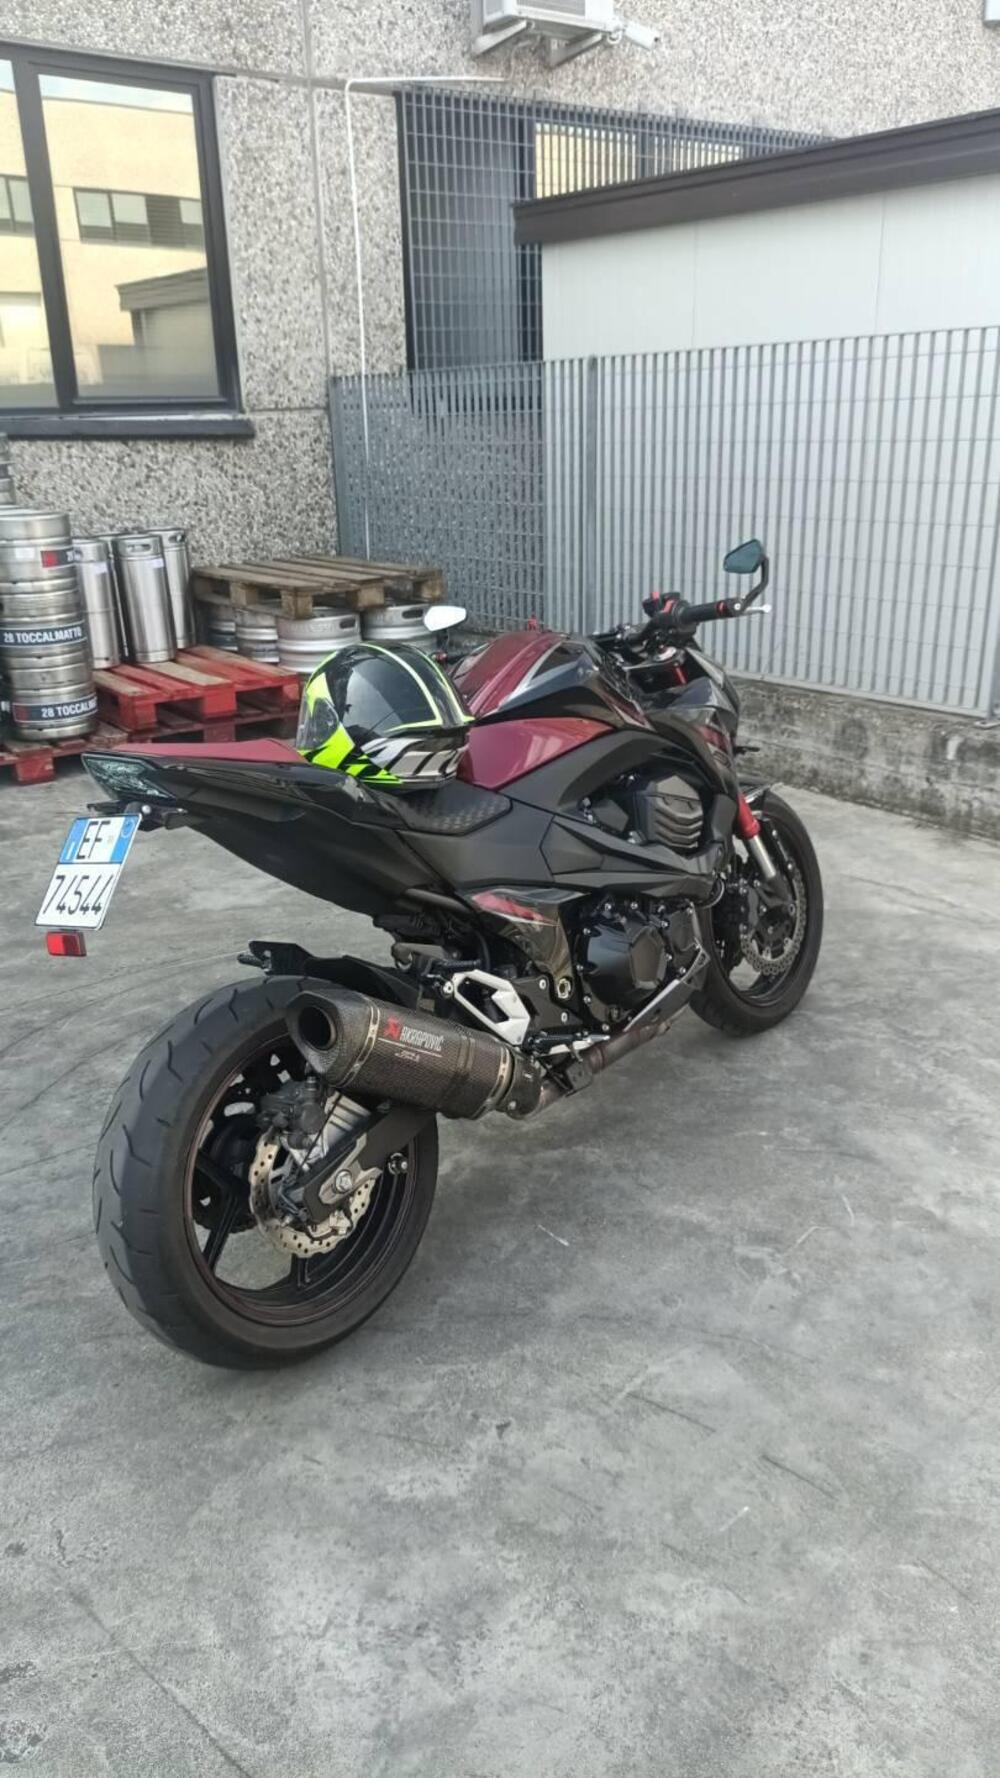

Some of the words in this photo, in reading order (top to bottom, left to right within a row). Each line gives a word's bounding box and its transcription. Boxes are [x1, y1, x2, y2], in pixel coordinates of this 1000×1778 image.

[16, 626, 82, 643] TOCCALMATTO
[41, 707, 55, 718] 28
[76, 820, 111, 859] EF
[42, 874, 114, 915] 74544
